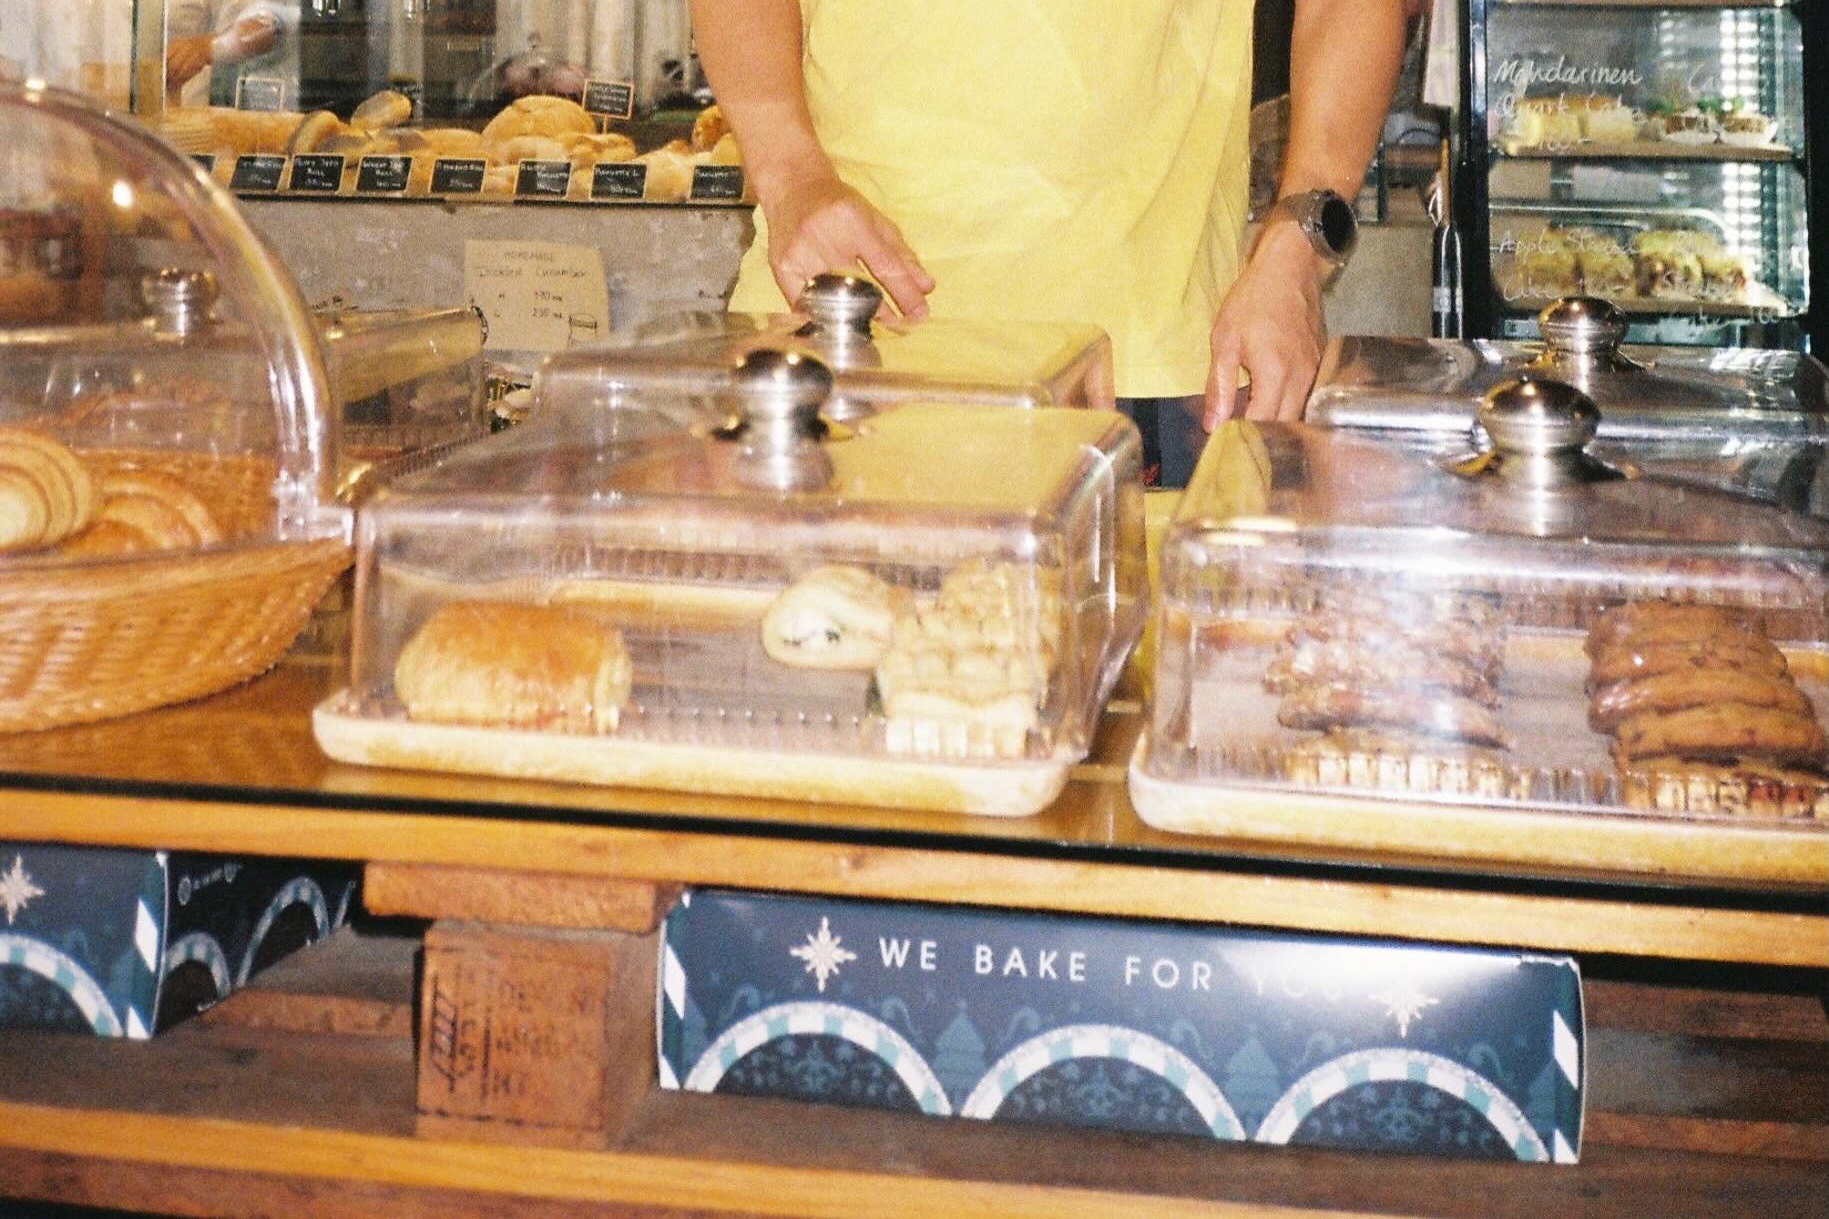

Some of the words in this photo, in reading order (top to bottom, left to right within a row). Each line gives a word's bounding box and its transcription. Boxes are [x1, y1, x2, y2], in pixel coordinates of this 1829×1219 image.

[879, 937, 937, 971] WE
[974, 944, 1086, 982] BAKE
[1124, 956, 1212, 991] FOR
